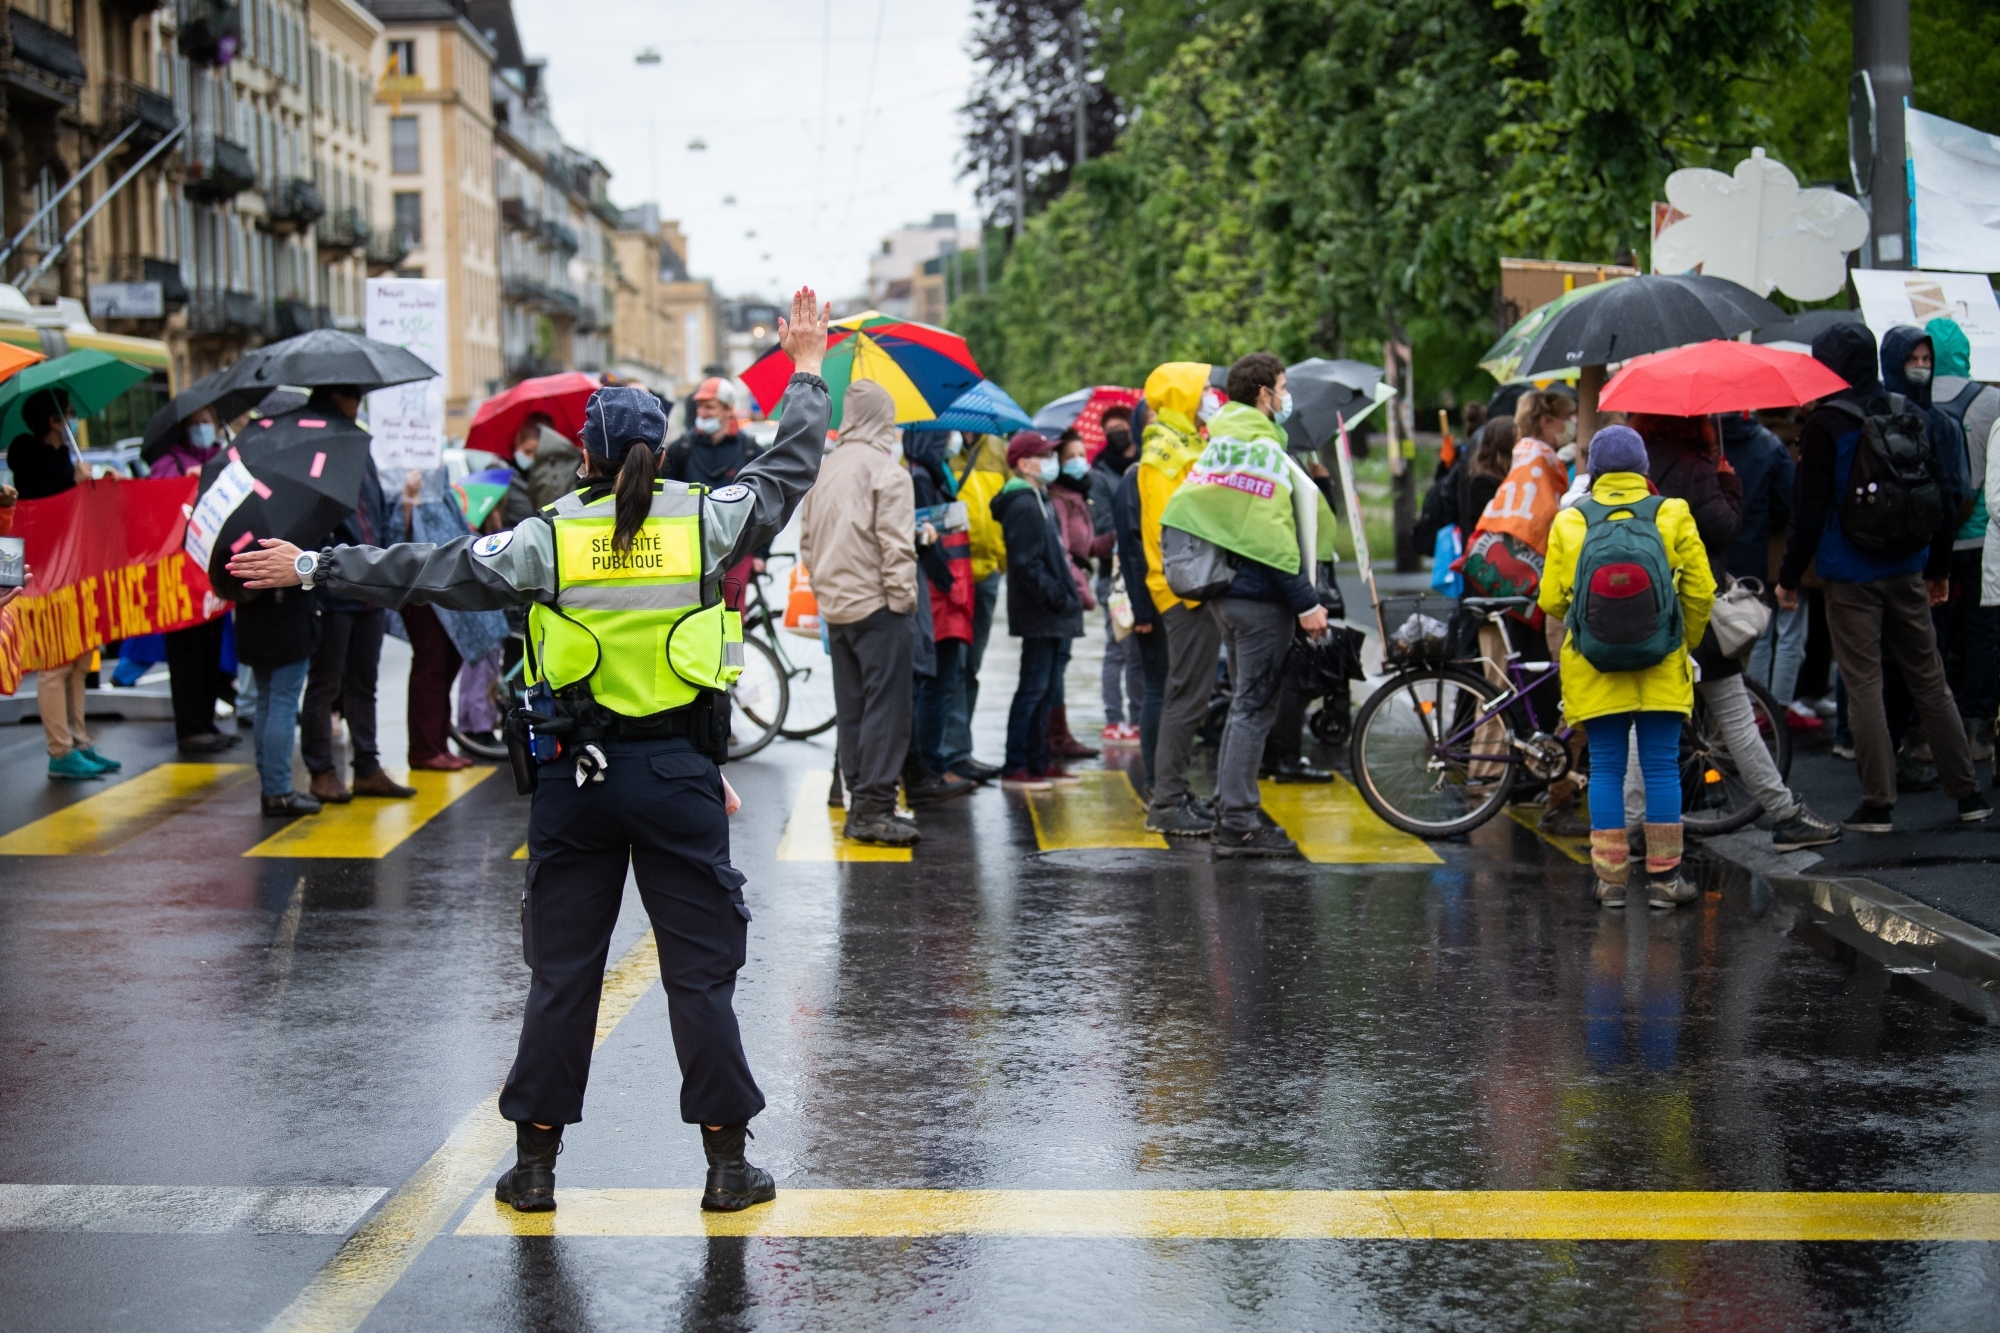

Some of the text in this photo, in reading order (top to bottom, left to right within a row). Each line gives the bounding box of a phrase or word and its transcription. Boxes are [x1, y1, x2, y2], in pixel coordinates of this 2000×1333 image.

[592, 533, 662, 552] SÉRITÉ
[592, 554, 663, 570] PUBLIQUE
[157, 553, 193, 628] AVS
